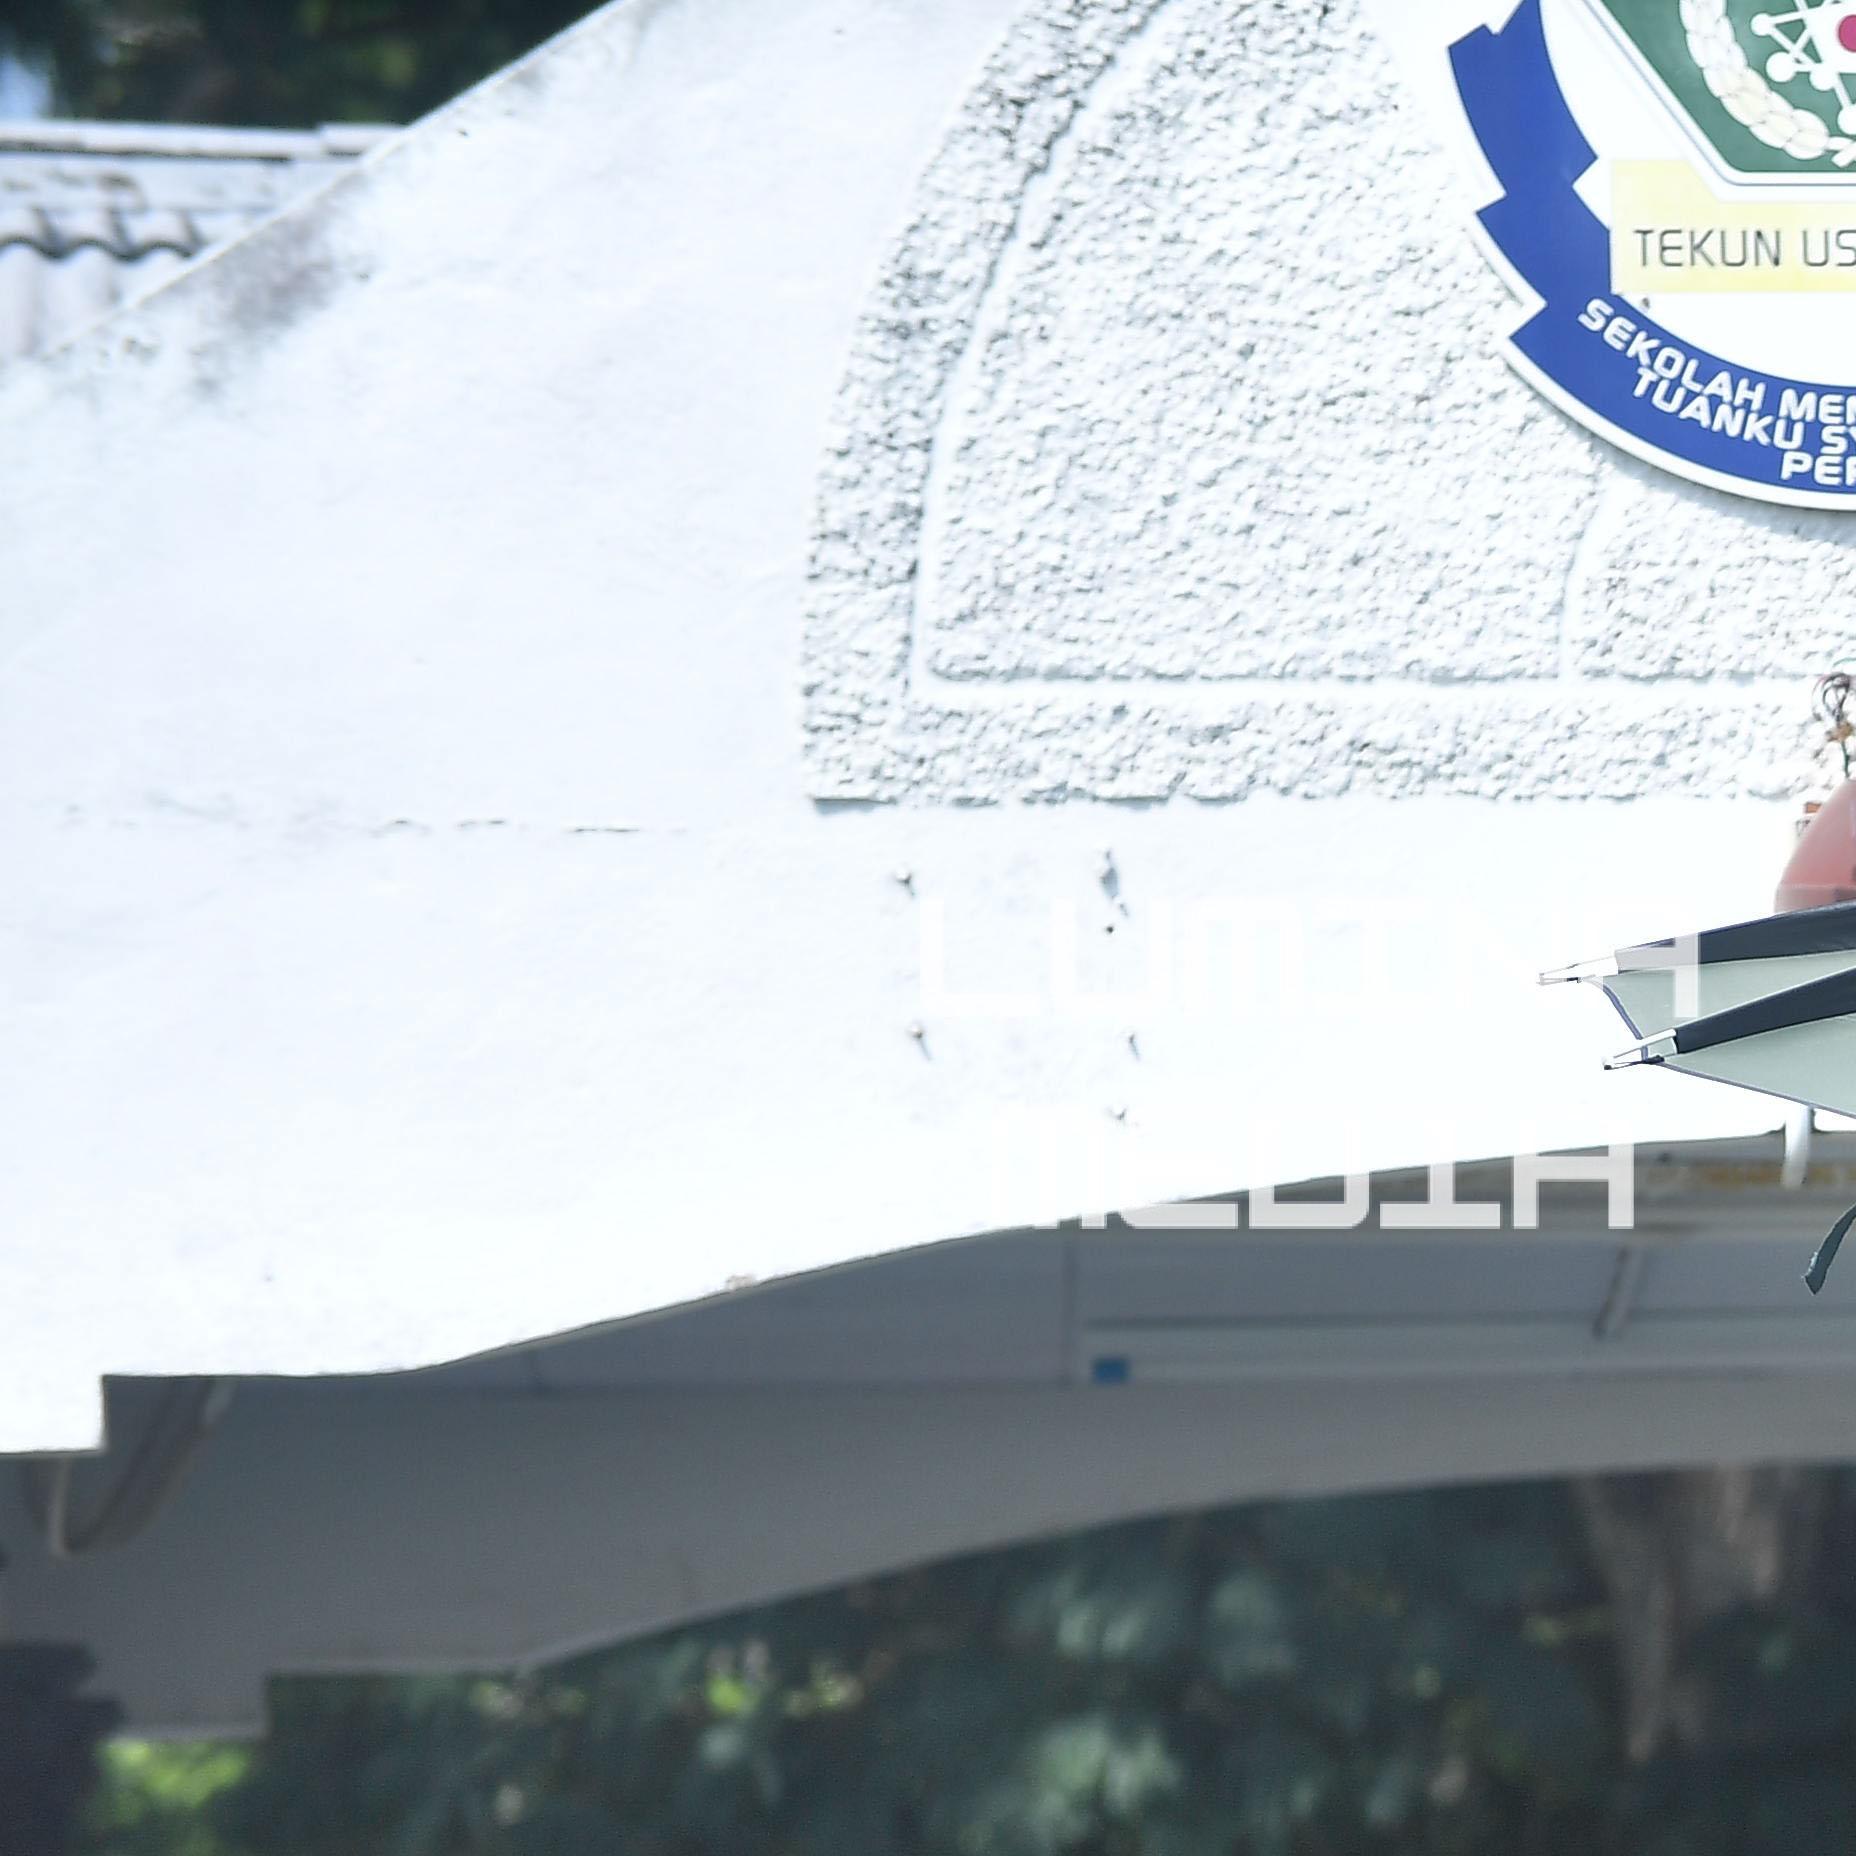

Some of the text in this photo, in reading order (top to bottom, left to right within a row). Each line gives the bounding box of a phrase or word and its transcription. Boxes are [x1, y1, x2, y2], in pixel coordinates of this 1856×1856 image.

[1632, 226, 1784, 269] TEKUN
[1576, 296, 1766, 413] SEKOLAH
[1631, 366, 1805, 453] TUANKU
